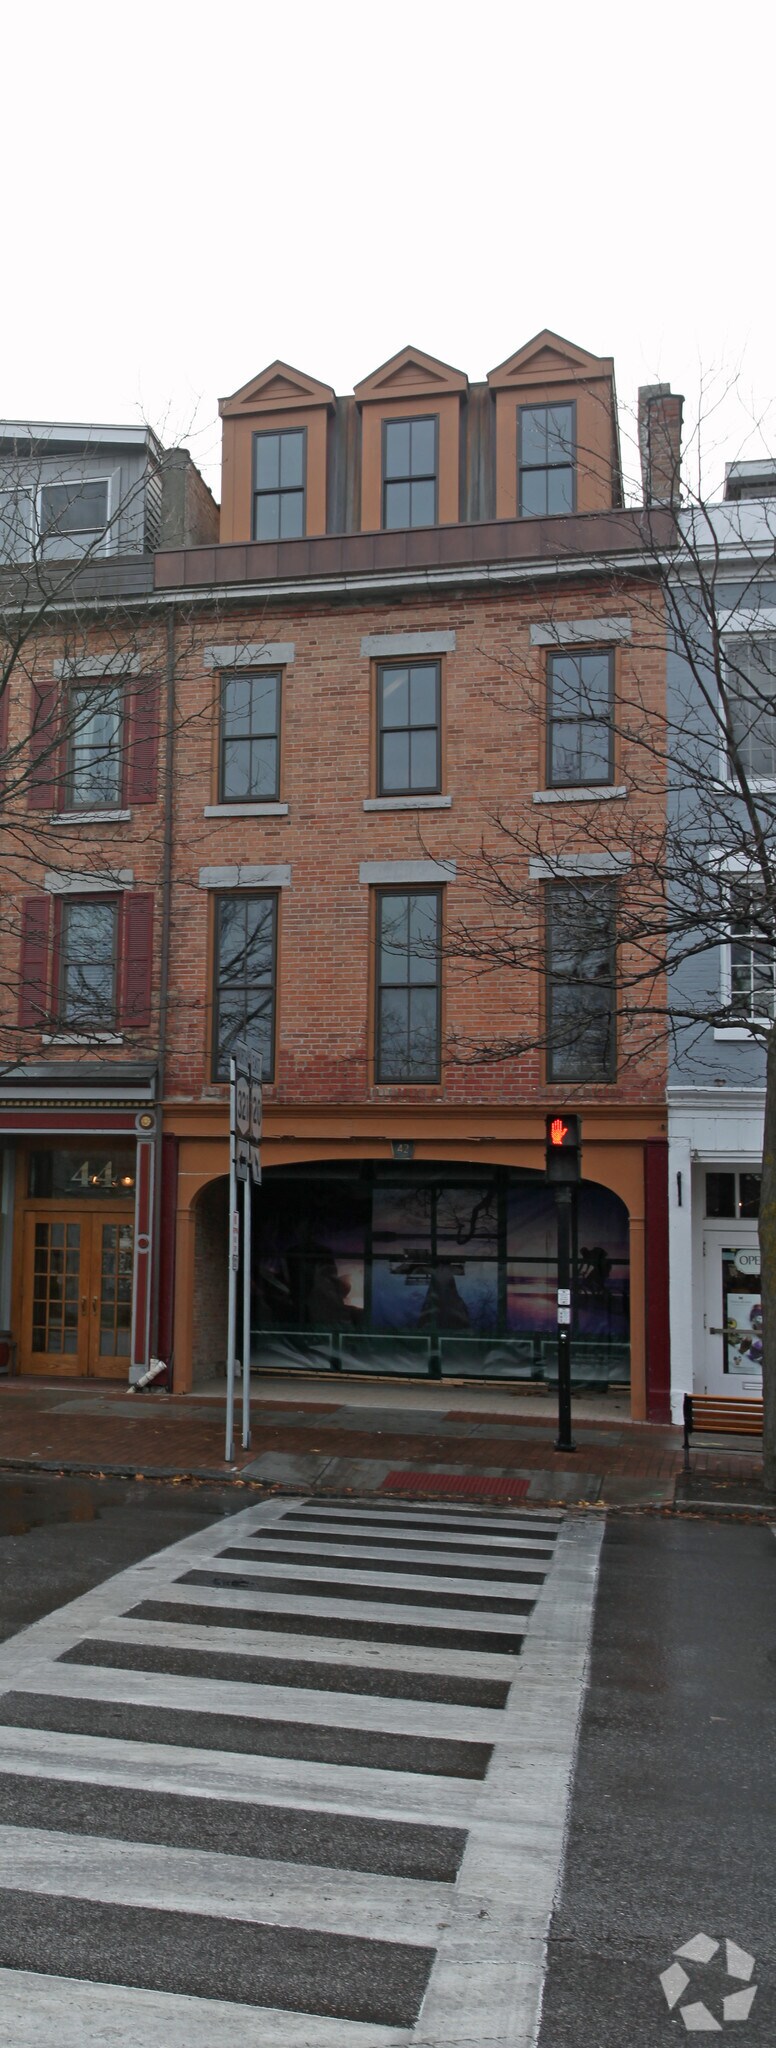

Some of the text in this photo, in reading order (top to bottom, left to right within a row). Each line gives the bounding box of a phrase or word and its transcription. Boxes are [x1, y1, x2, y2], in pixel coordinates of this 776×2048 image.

[397, 1143, 409, 1154] 42
[71, 1161, 115, 1188] 44
[739, 1255, 761, 1266] OPE
